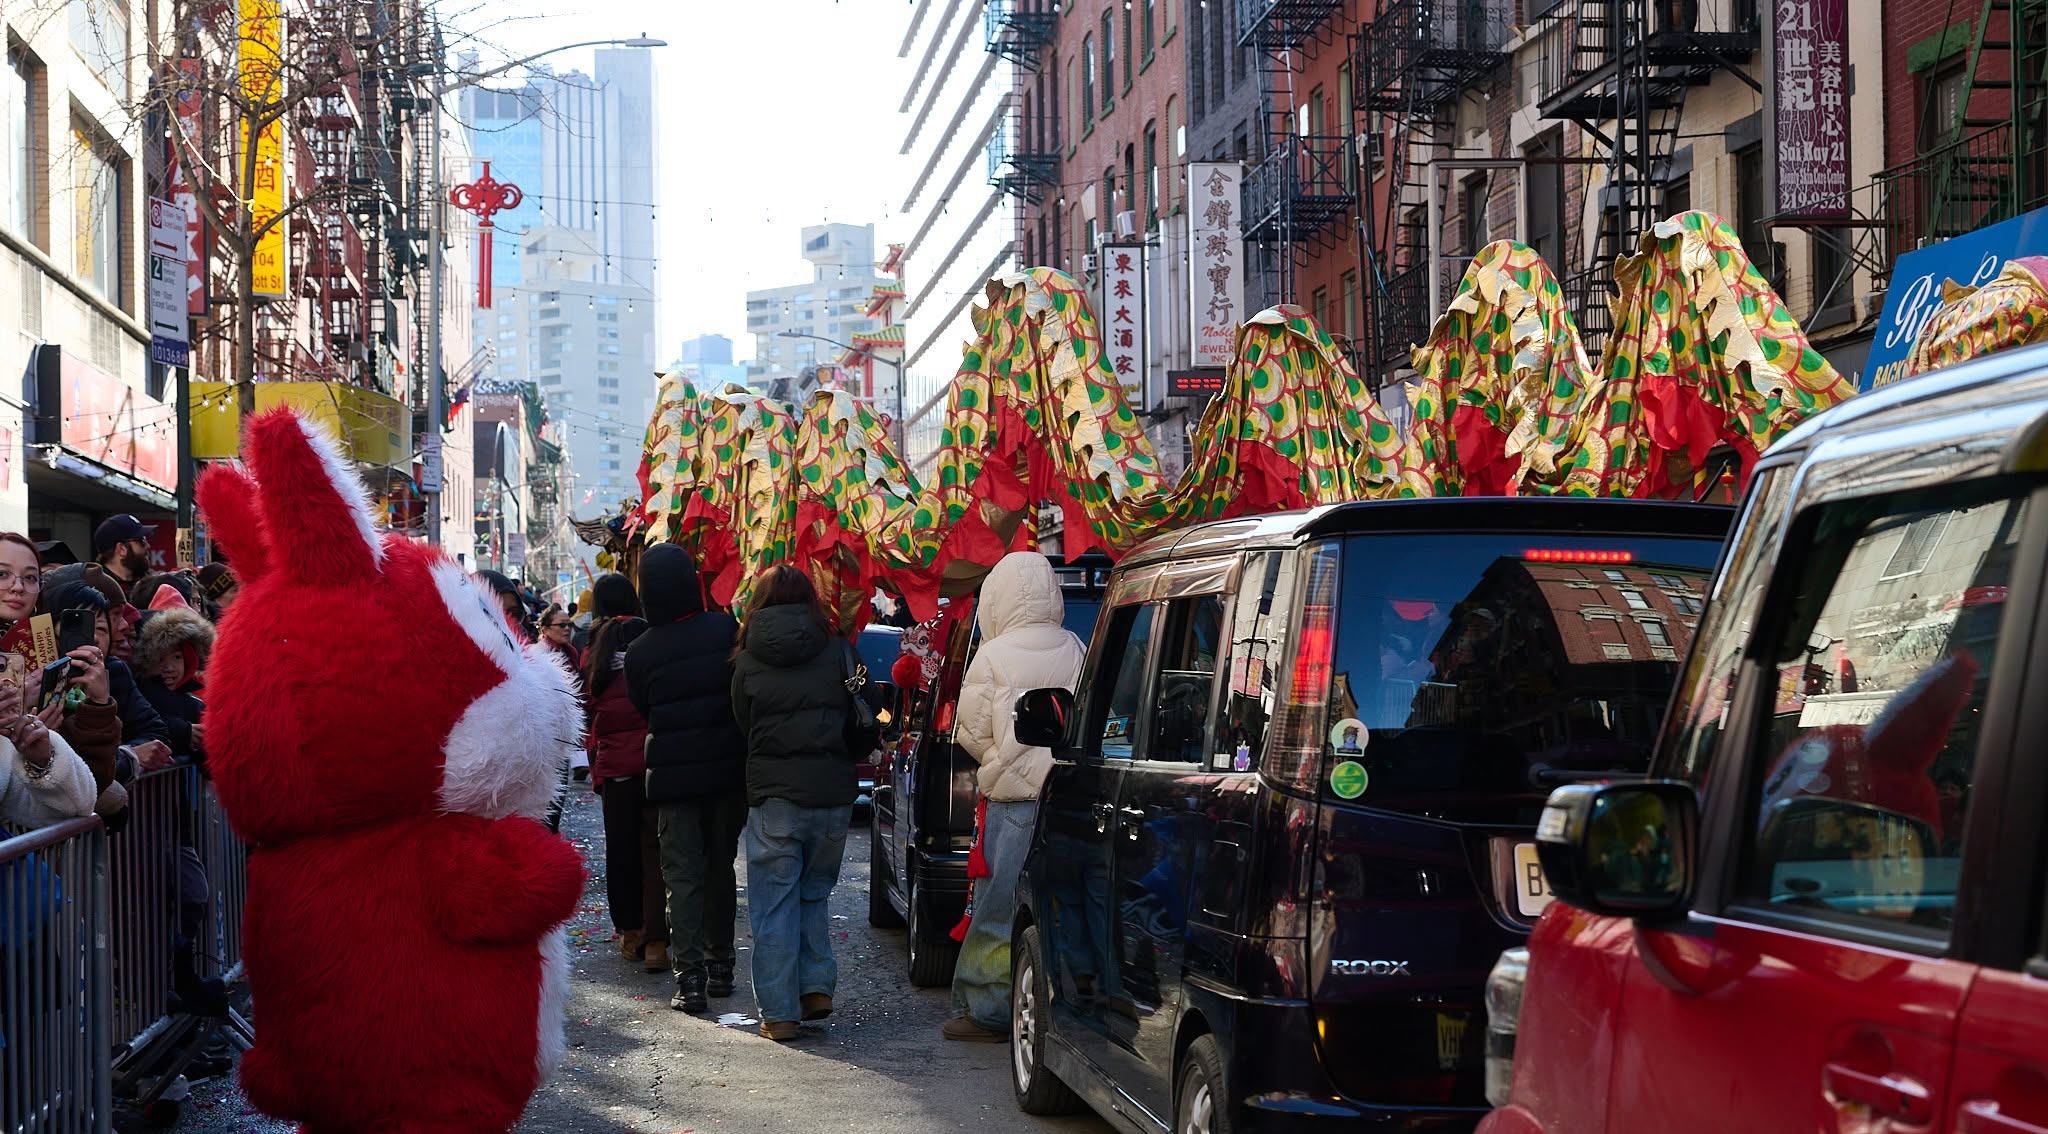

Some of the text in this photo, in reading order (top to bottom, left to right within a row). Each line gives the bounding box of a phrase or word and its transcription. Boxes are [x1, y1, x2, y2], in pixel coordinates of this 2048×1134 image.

[1819, 40, 1843, 137] 美容中心
[1779, 141, 1845, 165] Sai Kay 21
[1781, 192, 1846, 209] 219-9528
[154, 257, 161, 280] 2
[252, 274, 281, 289] ott St
[1113, 253, 1135, 375] 東來大酒家
[1201, 326, 1235, 338] Noble
[154, 345, 181, 364] 101368
[1199, 345, 1235, 354] JEWELR
[180, 552, 193, 562] TO
[36, 631, 47, 664] AANHPI
[45, 626, 54, 655] Stories
[1331, 959, 1411, 976] ROOX
